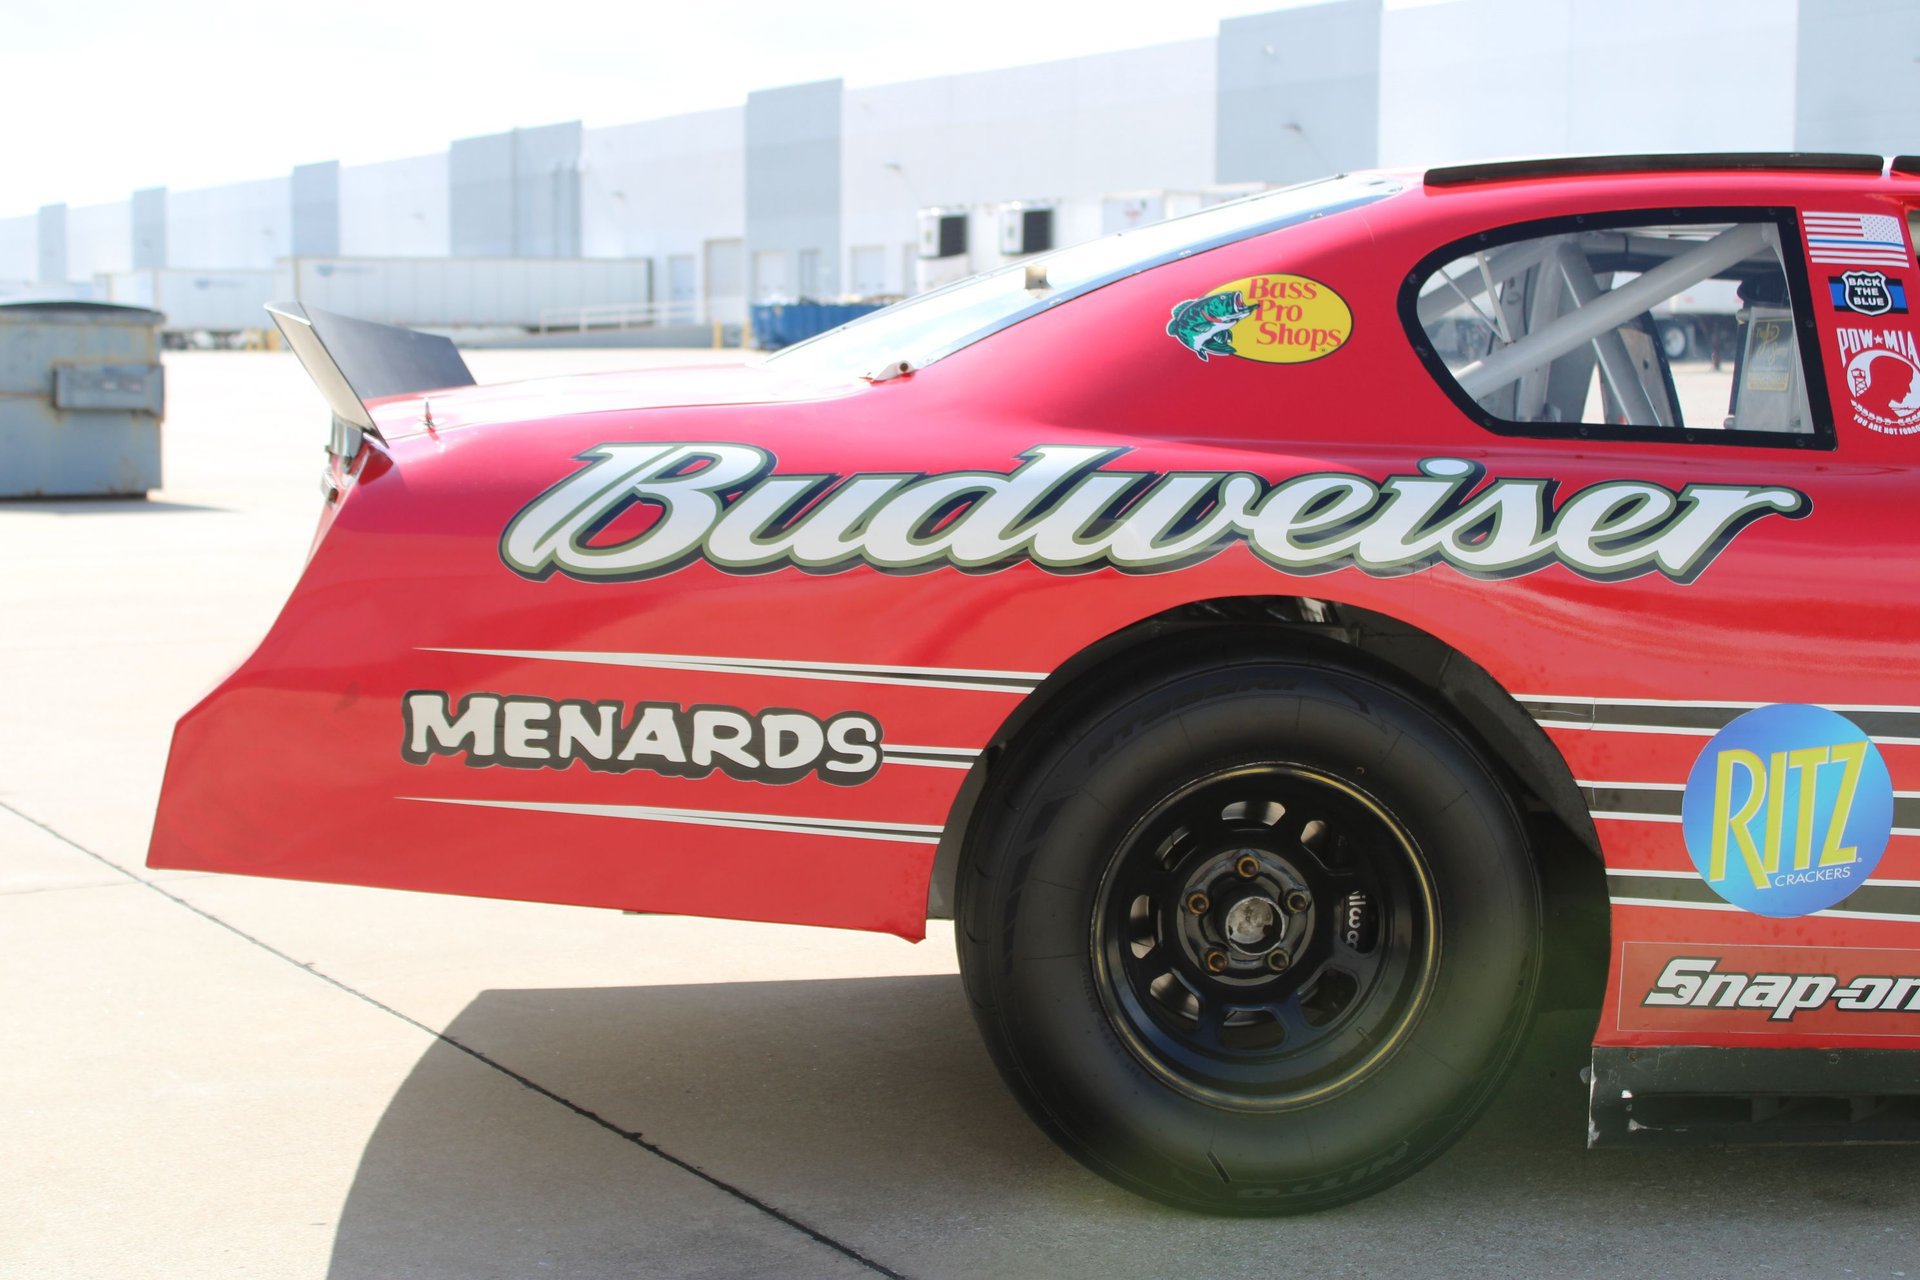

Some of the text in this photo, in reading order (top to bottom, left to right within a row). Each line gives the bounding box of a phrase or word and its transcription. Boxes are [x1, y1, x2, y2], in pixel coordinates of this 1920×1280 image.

[1248, 277, 1318, 300] Bass
[1848, 277, 1881, 287] BACK
[1854, 287, 1879, 296] THE
[1254, 299, 1303, 322] Pro
[1853, 296, 1885, 306] BLUE
[1256, 321, 1342, 352] Shops
[1836, 327, 1920, 370] POW MIA
[1853, 413, 1868, 427] YOU
[1868, 422, 1882, 433] ARE
[1884, 426, 1898, 435] NOT
[500, 442, 1812, 584] Budweiser
[404, 691, 882, 783] MENARDS
[1709, 741, 1868, 889] RITZ
[1774, 866, 1851, 887] CRACKERS
[1346, 890, 1367, 949] ilwo
[1643, 957, 1920, 1022] Snap-on
